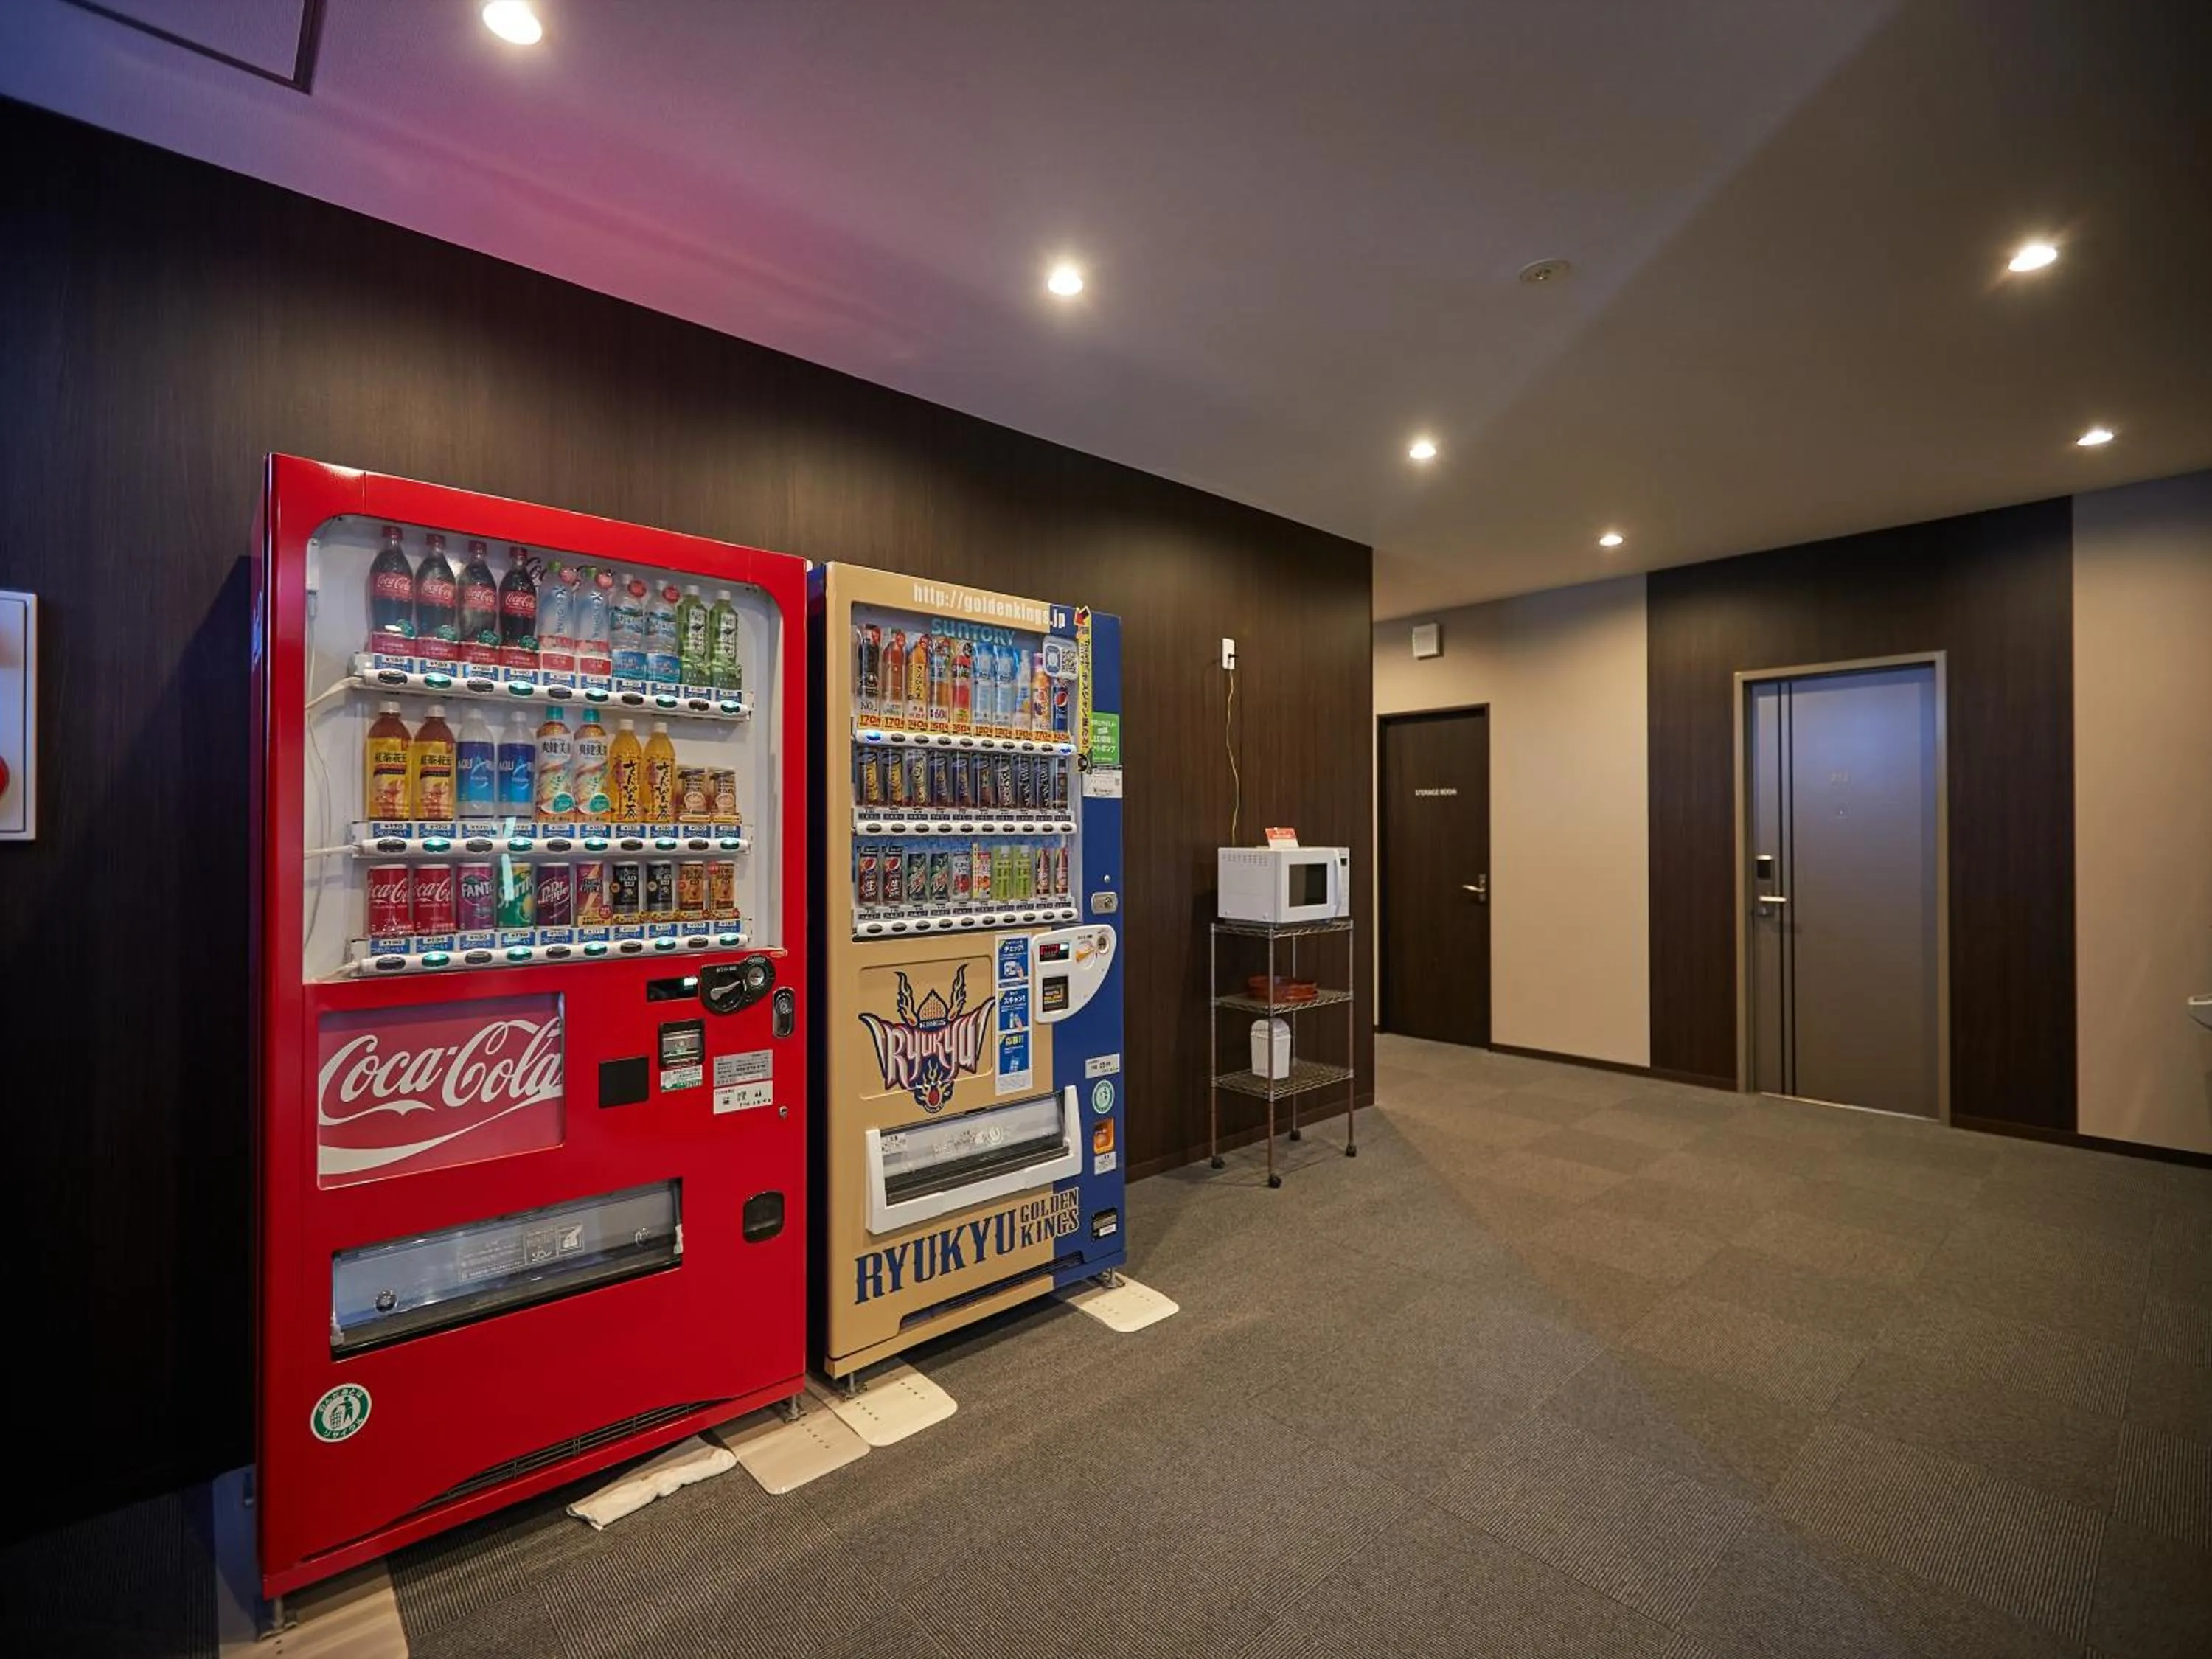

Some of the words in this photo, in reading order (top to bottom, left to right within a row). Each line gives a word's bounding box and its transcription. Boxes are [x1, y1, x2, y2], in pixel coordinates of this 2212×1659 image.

[913, 584, 1066, 630] http://goldenkings.jp
[319, 1016, 563, 1126] Coca-Cola
[1020, 1188, 1079, 1223] GOLDEN
[1020, 1208, 1079, 1248] KINGS
[855, 1209, 1016, 1304] RYUKYU
